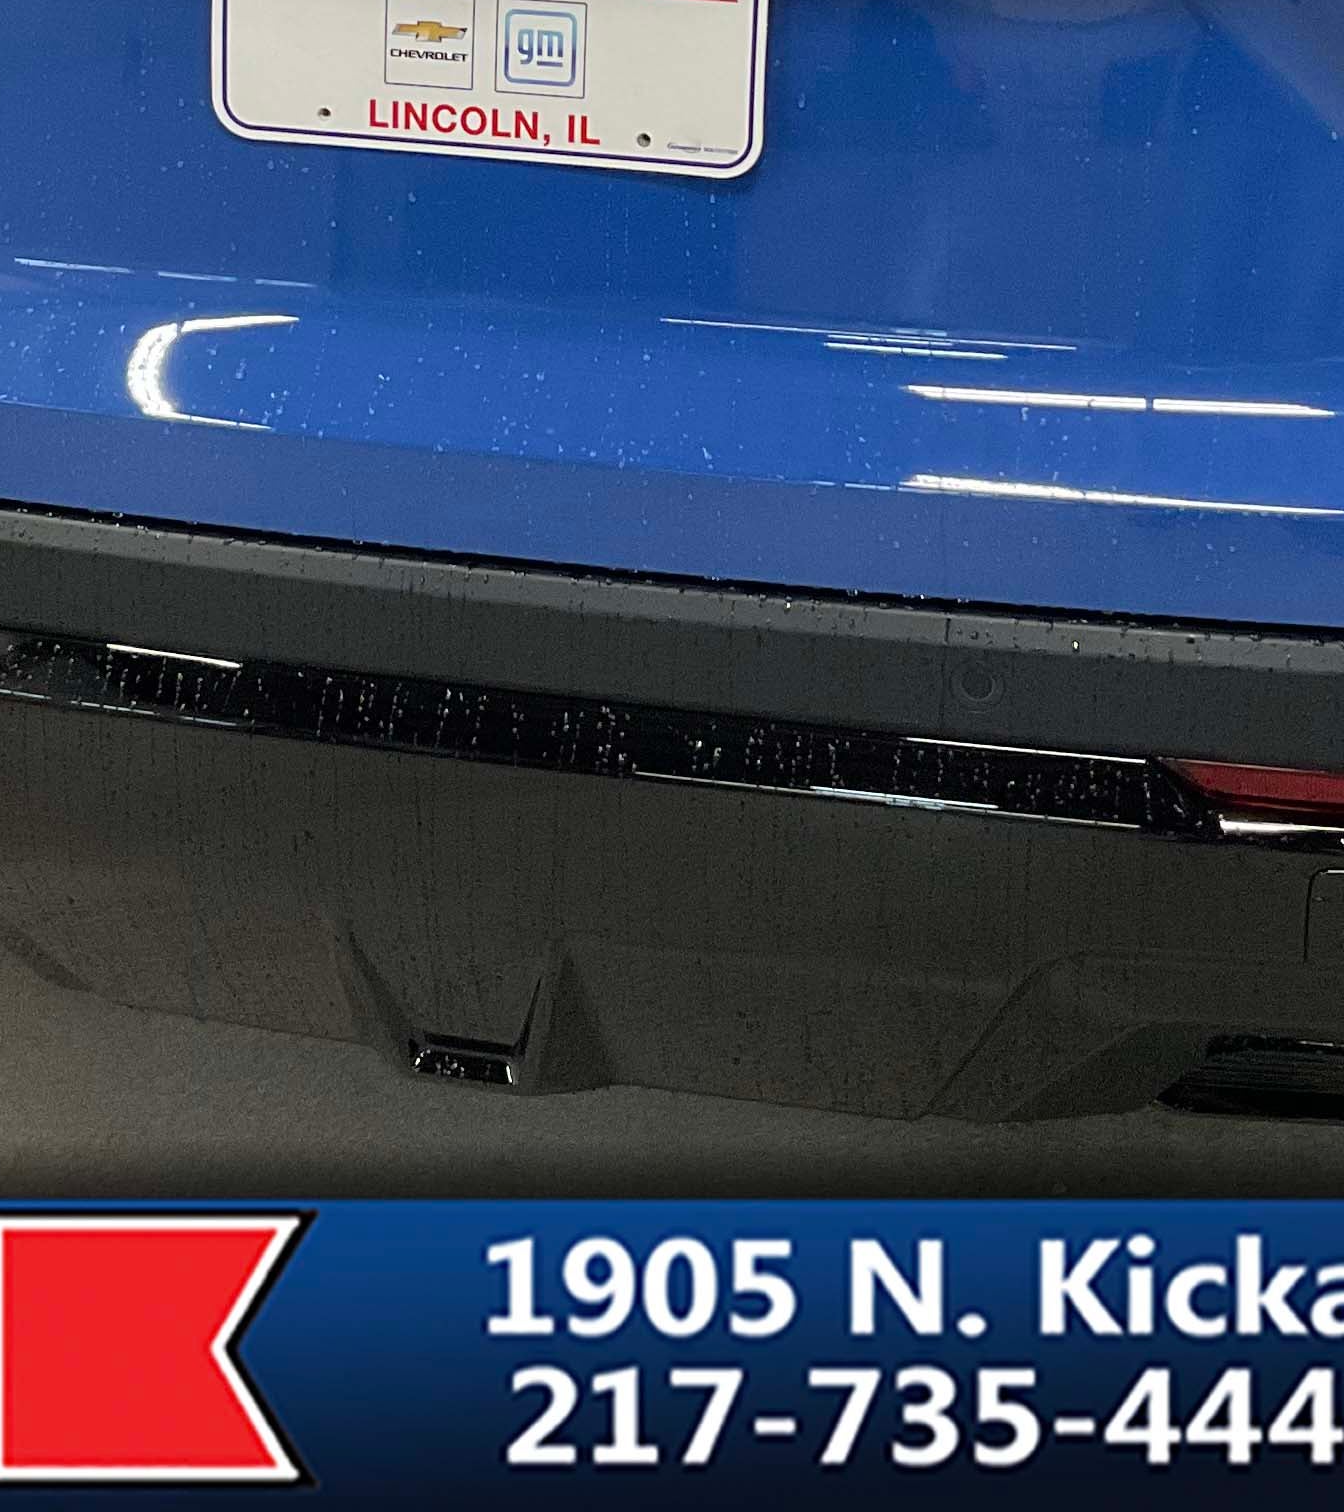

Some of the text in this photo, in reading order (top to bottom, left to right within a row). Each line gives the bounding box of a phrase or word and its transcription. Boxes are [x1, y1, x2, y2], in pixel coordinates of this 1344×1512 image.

[389, 47, 469, 63] CHEVROLET
[517, 27, 565, 68] gm
[369, 98, 601, 147] LINCOLN, IL
